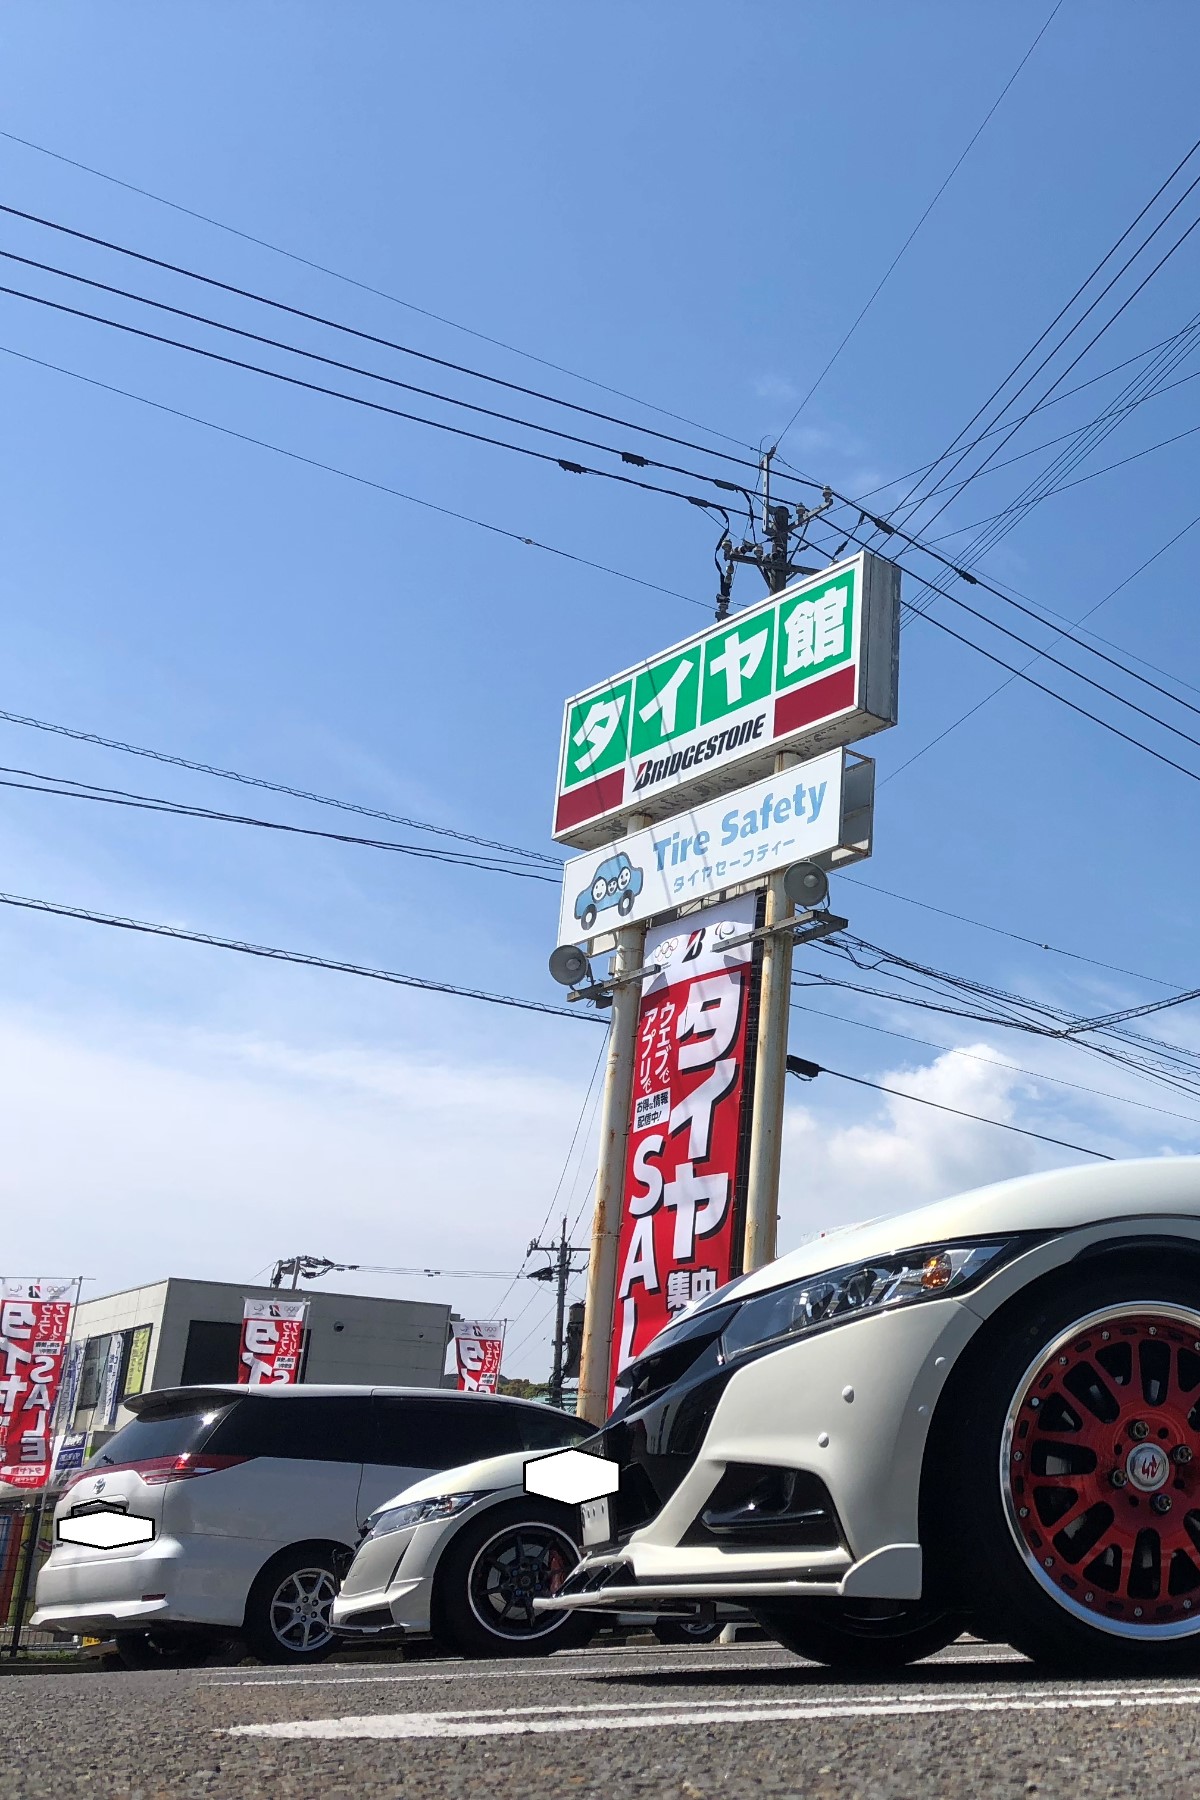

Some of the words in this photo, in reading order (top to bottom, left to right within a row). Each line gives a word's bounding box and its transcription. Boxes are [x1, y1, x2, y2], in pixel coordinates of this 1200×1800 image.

[572, 586, 849, 773] タイヤ館
[632, 713, 767, 792] BRIDGESTONE
[653, 830, 711, 872] Tire
[721, 780, 827, 847] Safety
[673, 838, 796, 893] タイヤセーフティー
[639, 1006, 659, 1094] アプリで
[663, 971, 742, 1260] タイヤ
